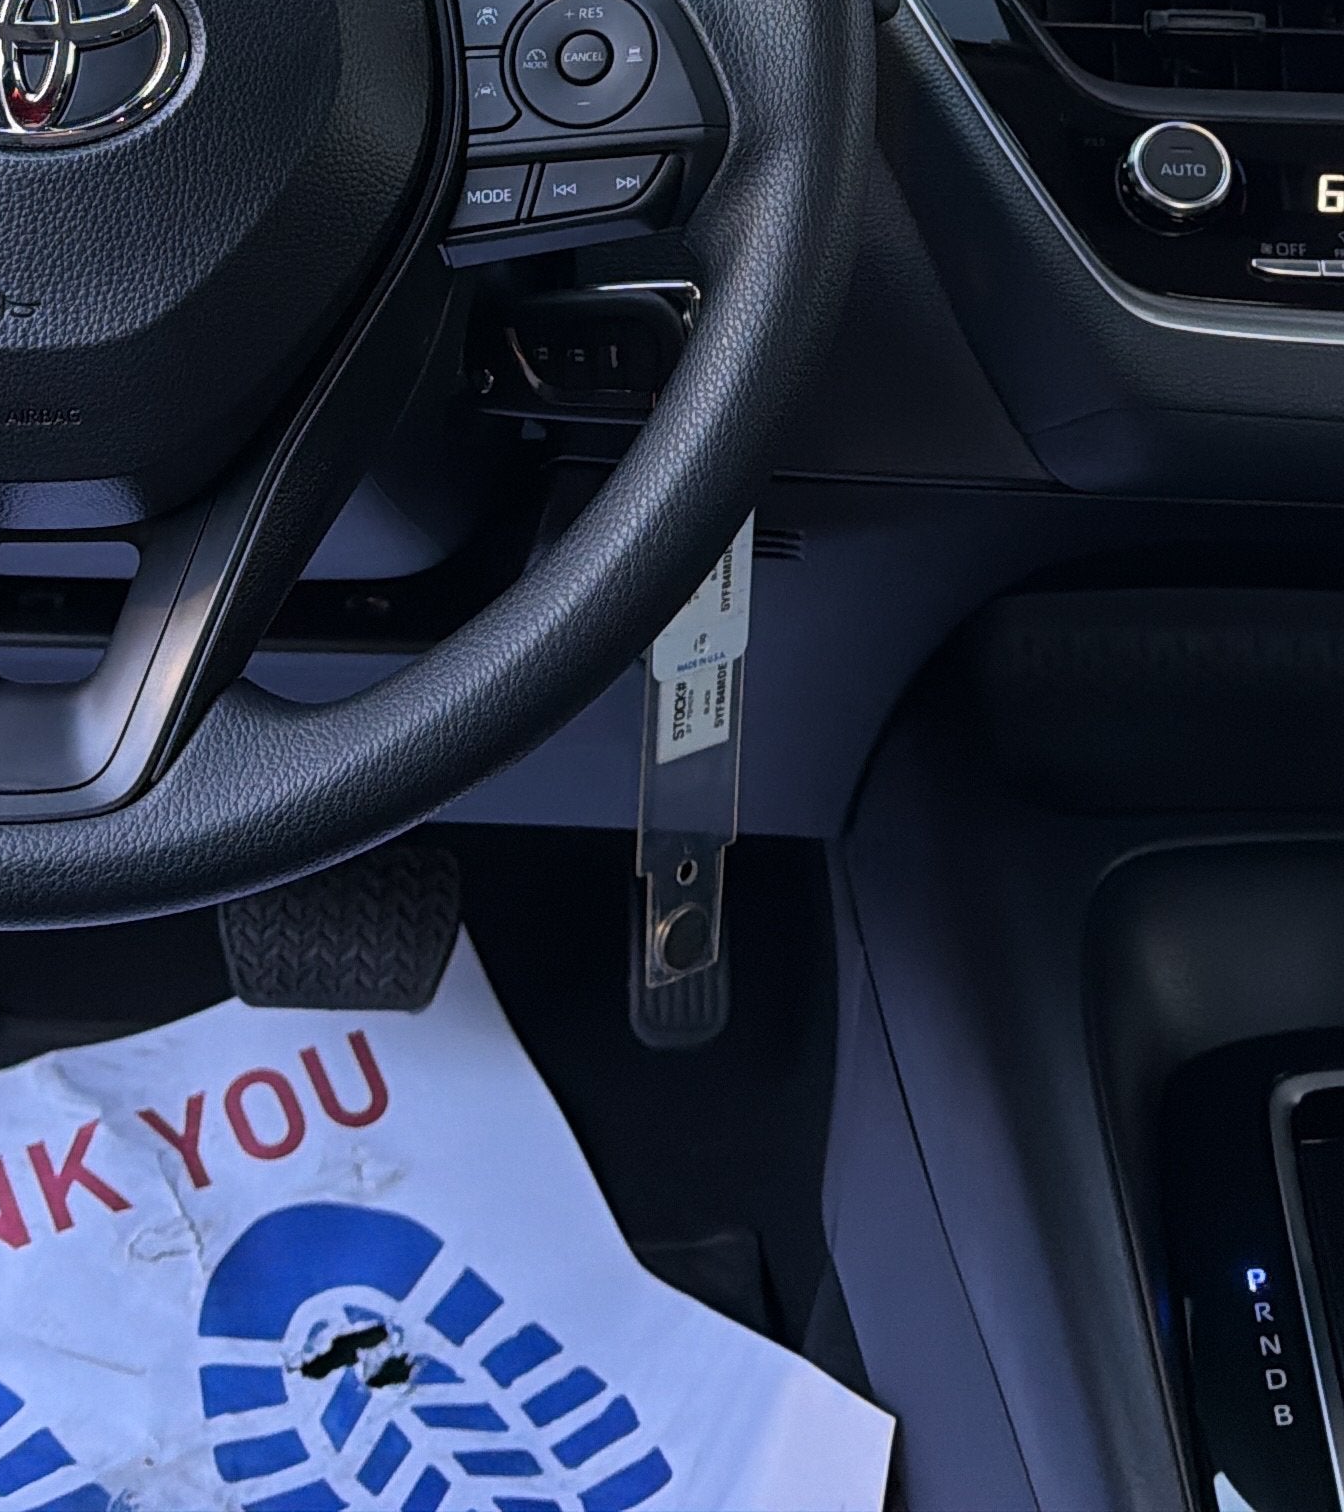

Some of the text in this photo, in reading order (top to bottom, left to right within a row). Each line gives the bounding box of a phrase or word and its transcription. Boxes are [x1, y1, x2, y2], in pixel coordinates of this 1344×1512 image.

[579, 7, 604, 19] RES
[523, 61, 548, 69] MODE
[563, 52, 604, 63] CANCEL
[1160, 163, 1206, 177] AUTO
[467, 189, 512, 205] MODE
[1276, 242, 1306, 257] OFF
[5, 409, 82, 426] AIRBAG
[672, 681, 687, 741] STOCK#
[138, 1029, 390, 1190] YOU
[1247, 1268, 1266, 1293] P
[1254, 1301, 1274, 1322] R
[1259, 1334, 1282, 1356] N
[1265, 1369, 1287, 1390] D
[1273, 1404, 1294, 1426] B
